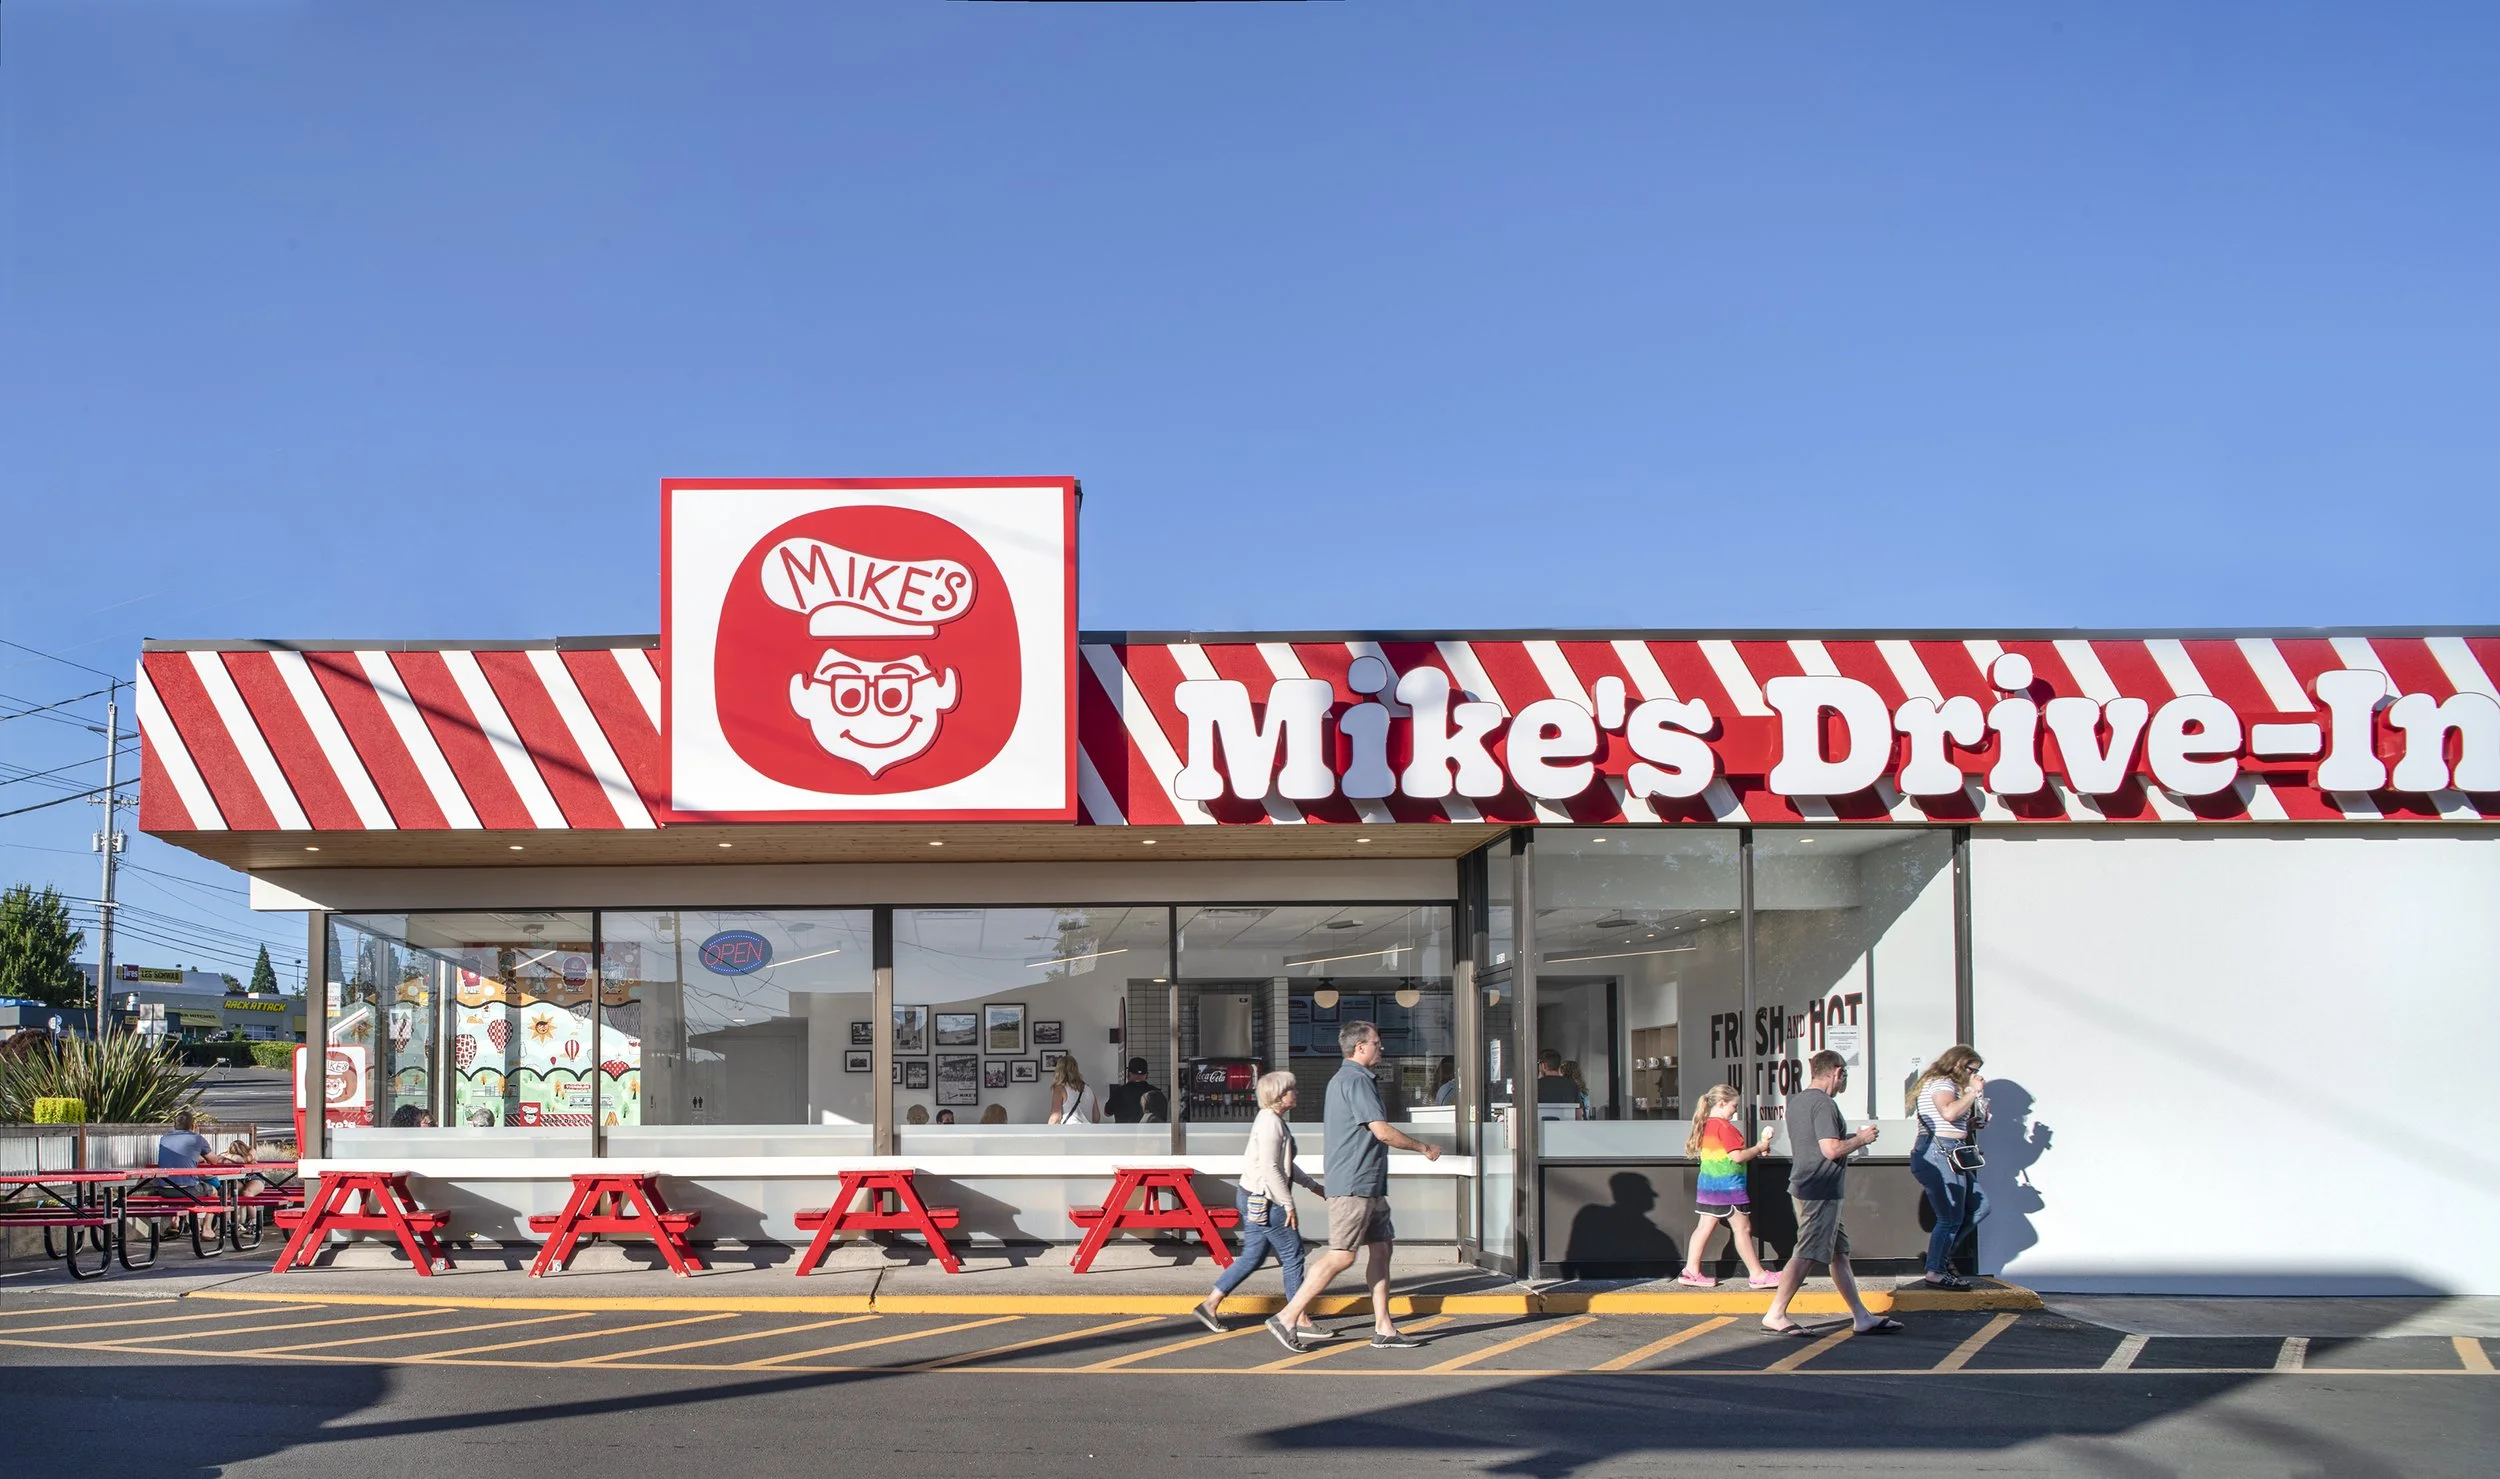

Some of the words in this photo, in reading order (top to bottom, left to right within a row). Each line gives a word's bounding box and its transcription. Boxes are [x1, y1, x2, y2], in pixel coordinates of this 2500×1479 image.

[780, 544, 966, 616] MIKE'S
[1174, 655, 1716, 800] Mike's
[1765, 653, 2500, 797] Drive-In
[704, 941, 764, 966] OPEN
[141, 970, 152, 979] LES
[153, 971, 179, 981] SCHWAB
[224, 1000, 249, 1010] RACK
[250, 1001, 286, 1012] ATTACK
[1711, 1004, 1784, 1059] FRSH
[1786, 1014, 1806, 1039] AND
[327, 1060, 349, 1072] IKE'S
[1768, 1058, 1803, 1096] FOR
